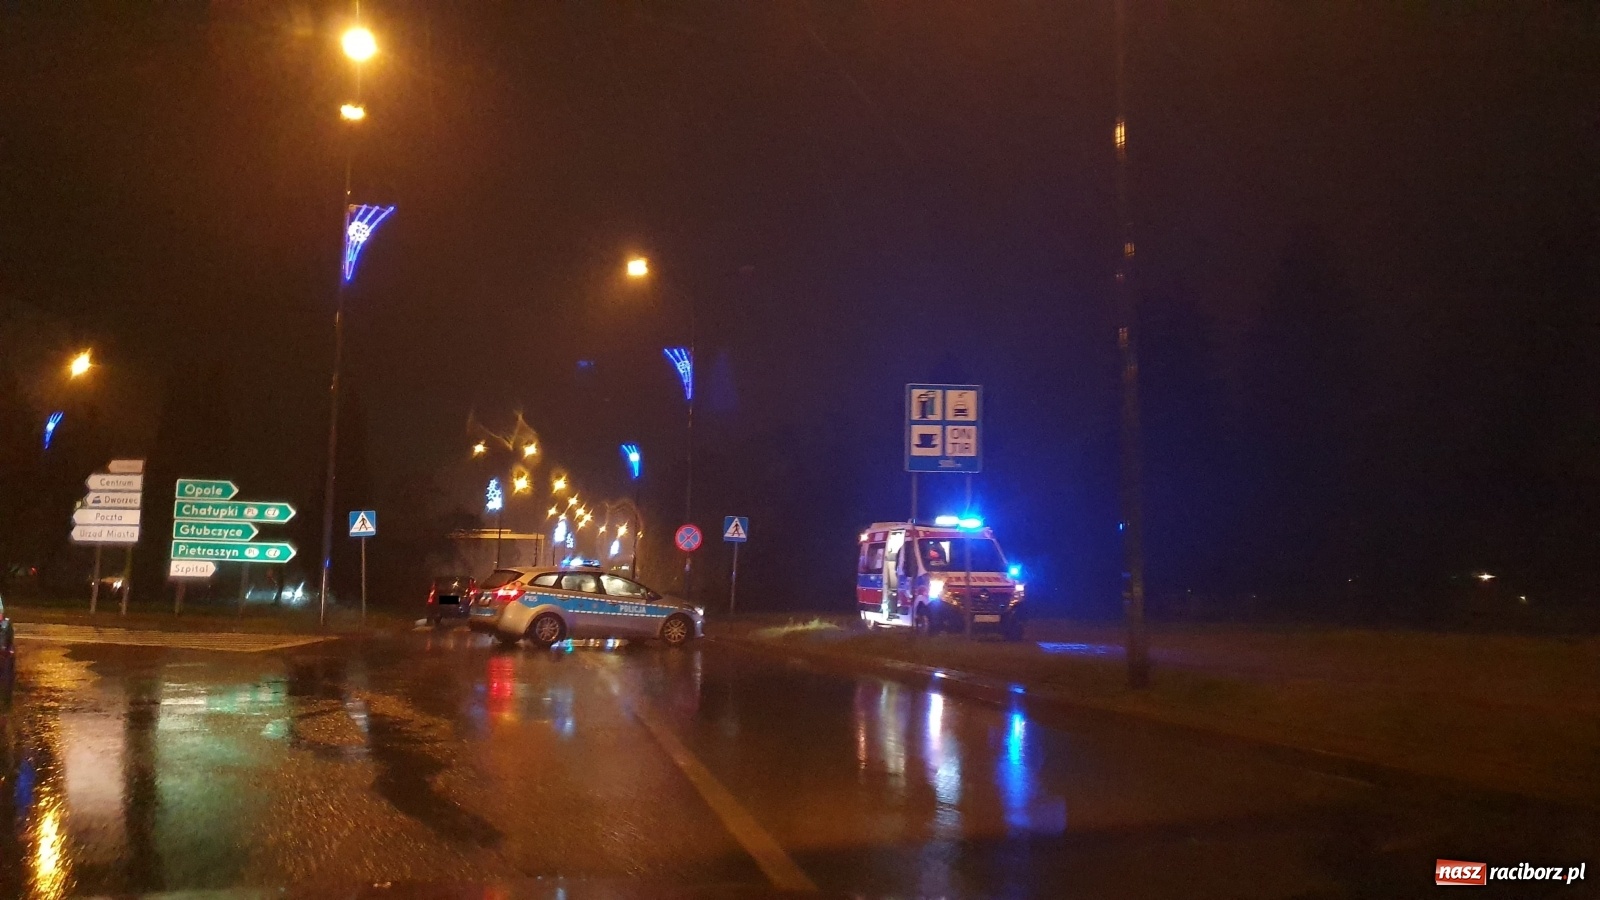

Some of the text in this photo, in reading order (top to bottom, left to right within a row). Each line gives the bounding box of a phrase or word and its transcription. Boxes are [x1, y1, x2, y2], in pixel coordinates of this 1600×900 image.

[100, 478, 134, 487] Centrum
[184, 484, 223, 498] Opole
[104, 496, 138, 504] Dworzec
[182, 504, 238, 518] Chałupki
[95, 512, 123, 521] Poczta
[106, 530, 135, 538] Miasta
[180, 524, 243, 538] Głubczyce
[178, 544, 239, 559] Pietraszyn
[174, 564, 209, 574] Szpital
[619, 604, 646, 614] POLICJA
